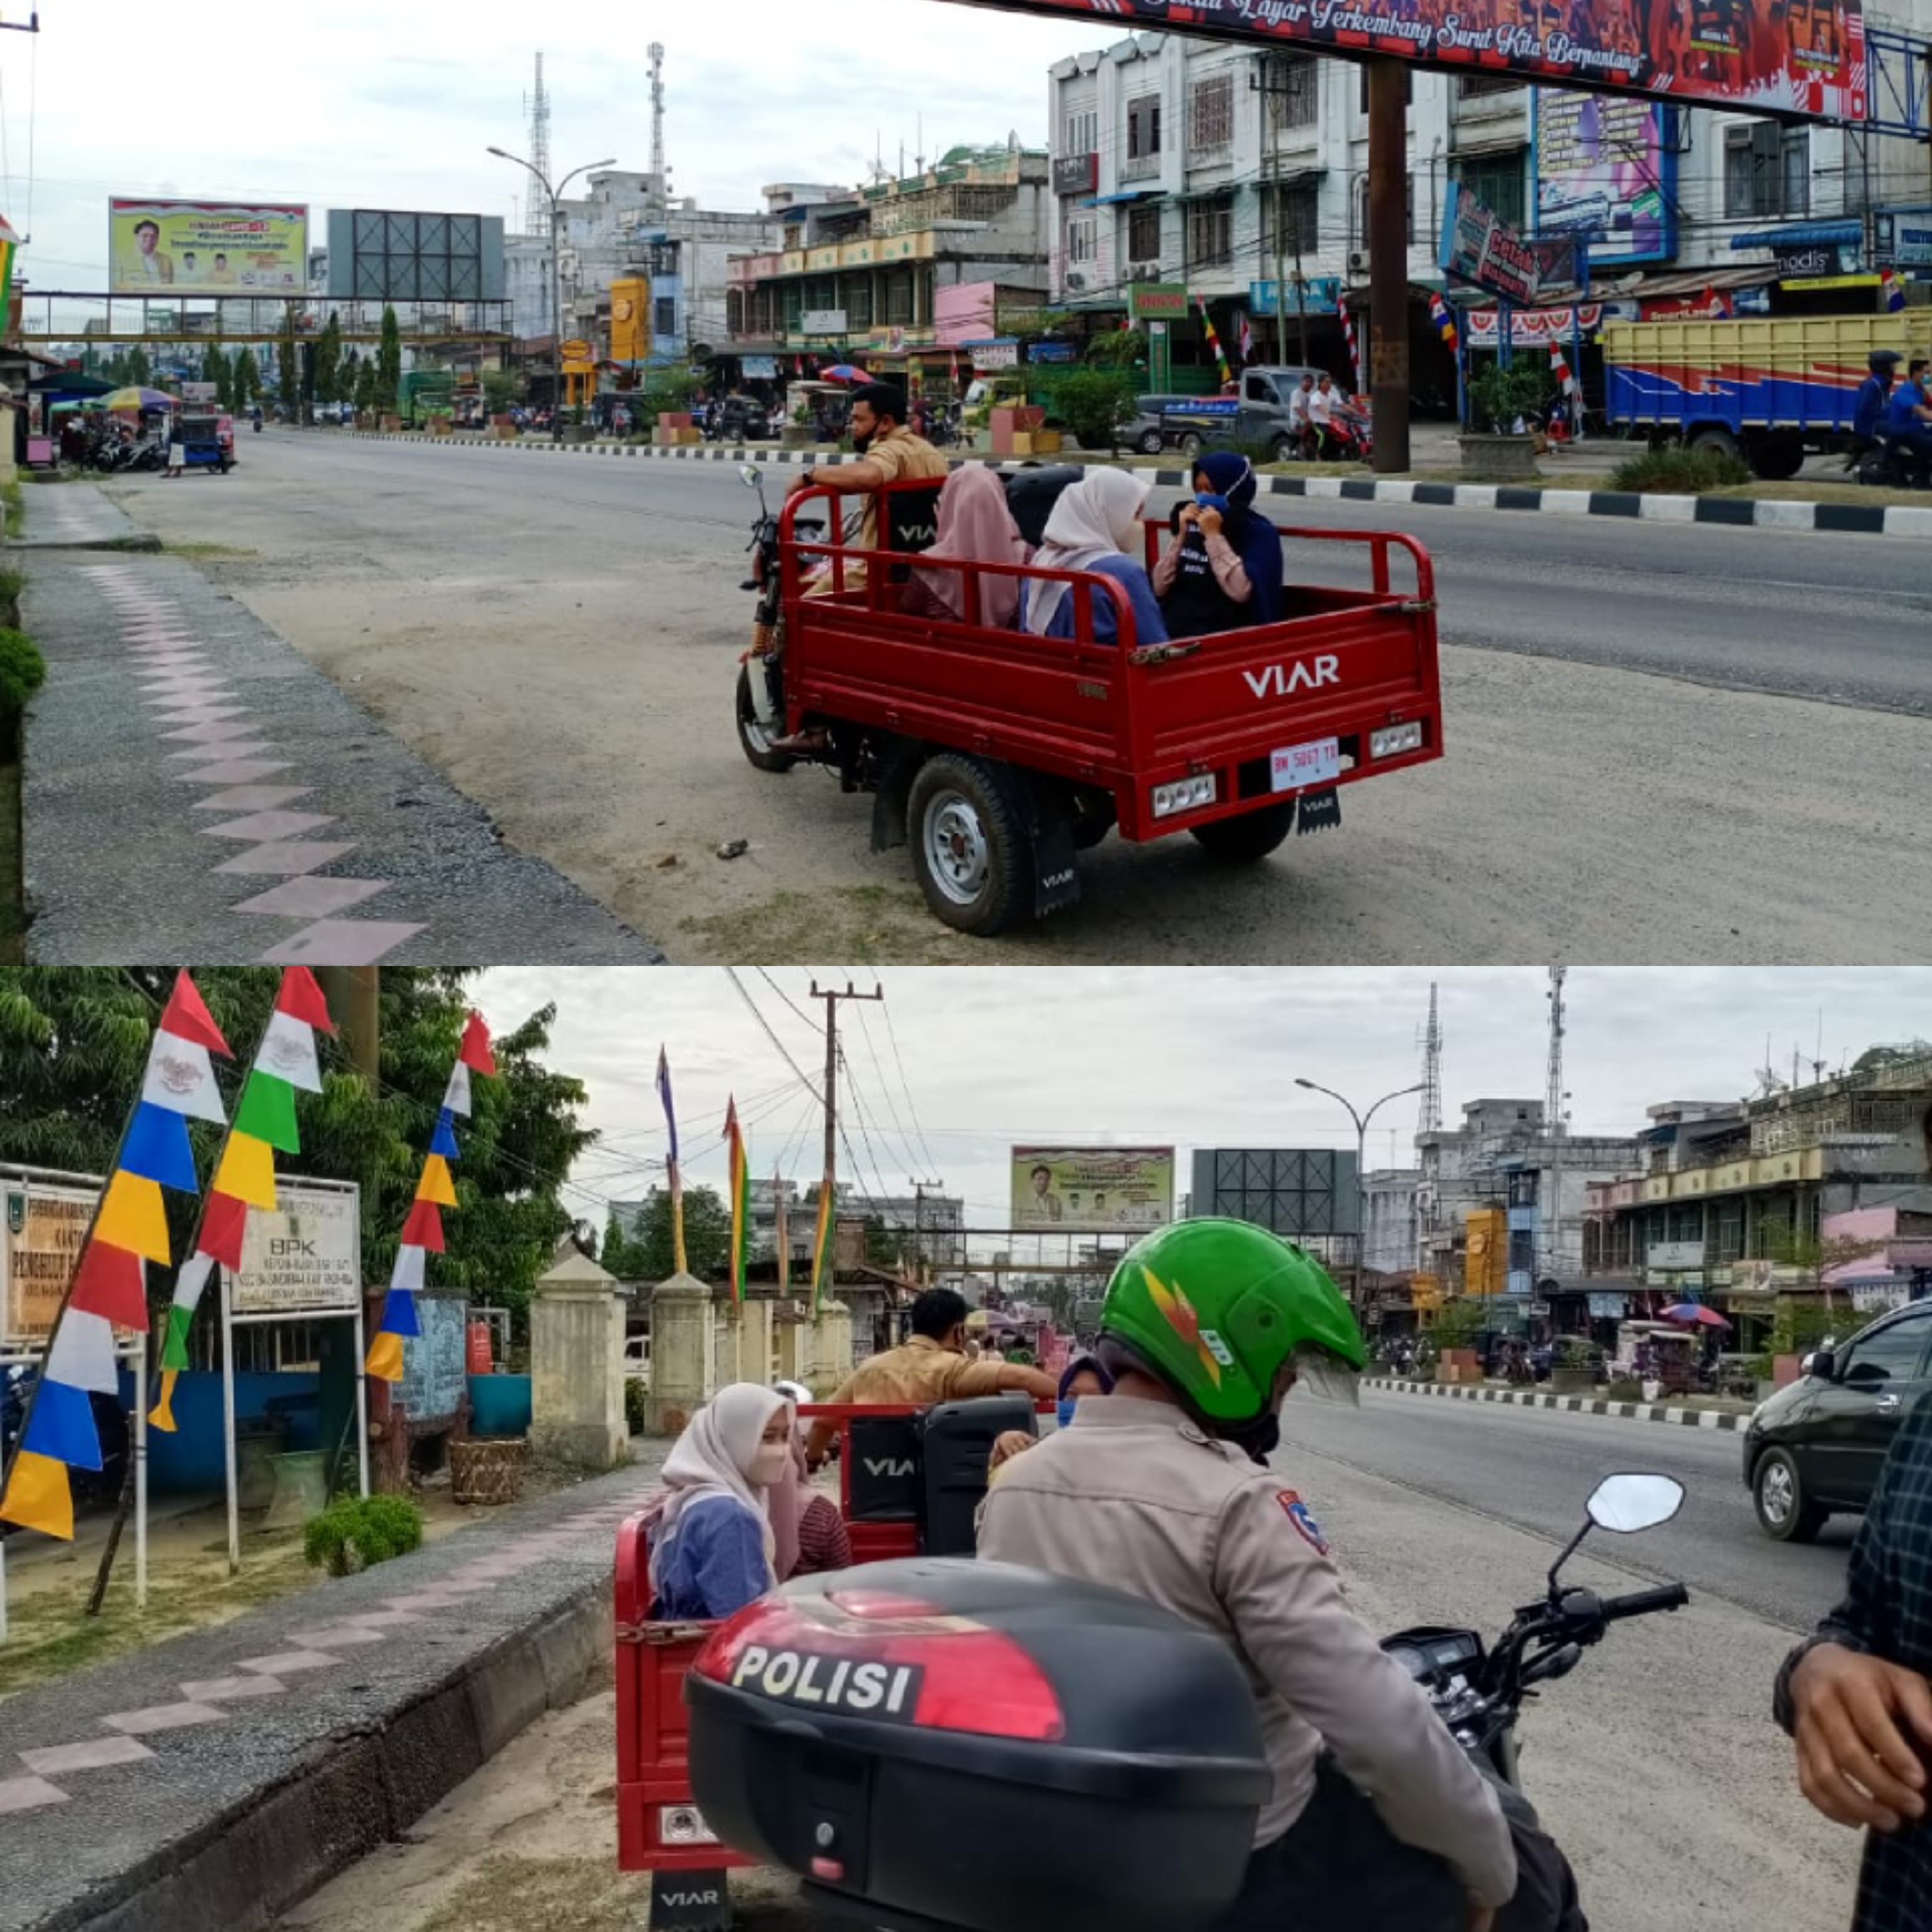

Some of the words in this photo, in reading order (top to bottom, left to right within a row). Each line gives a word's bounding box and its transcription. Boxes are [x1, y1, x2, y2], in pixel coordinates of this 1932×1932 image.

[1309, 0, 1432, 48] Terkembang
[1436, 13, 1492, 49] Surut
[1496, 23, 1541, 58] Kita
[898, 524, 937, 542] VIA
[1242, 653, 1342, 699] VIAR
[1042, 868, 1074, 889] VIAR
[270, 1238, 316, 1256] BPK
[863, 1458, 915, 1476] VIA
[732, 1644, 911, 1713] POLISI
[660, 1889, 718, 1907] VIAR
